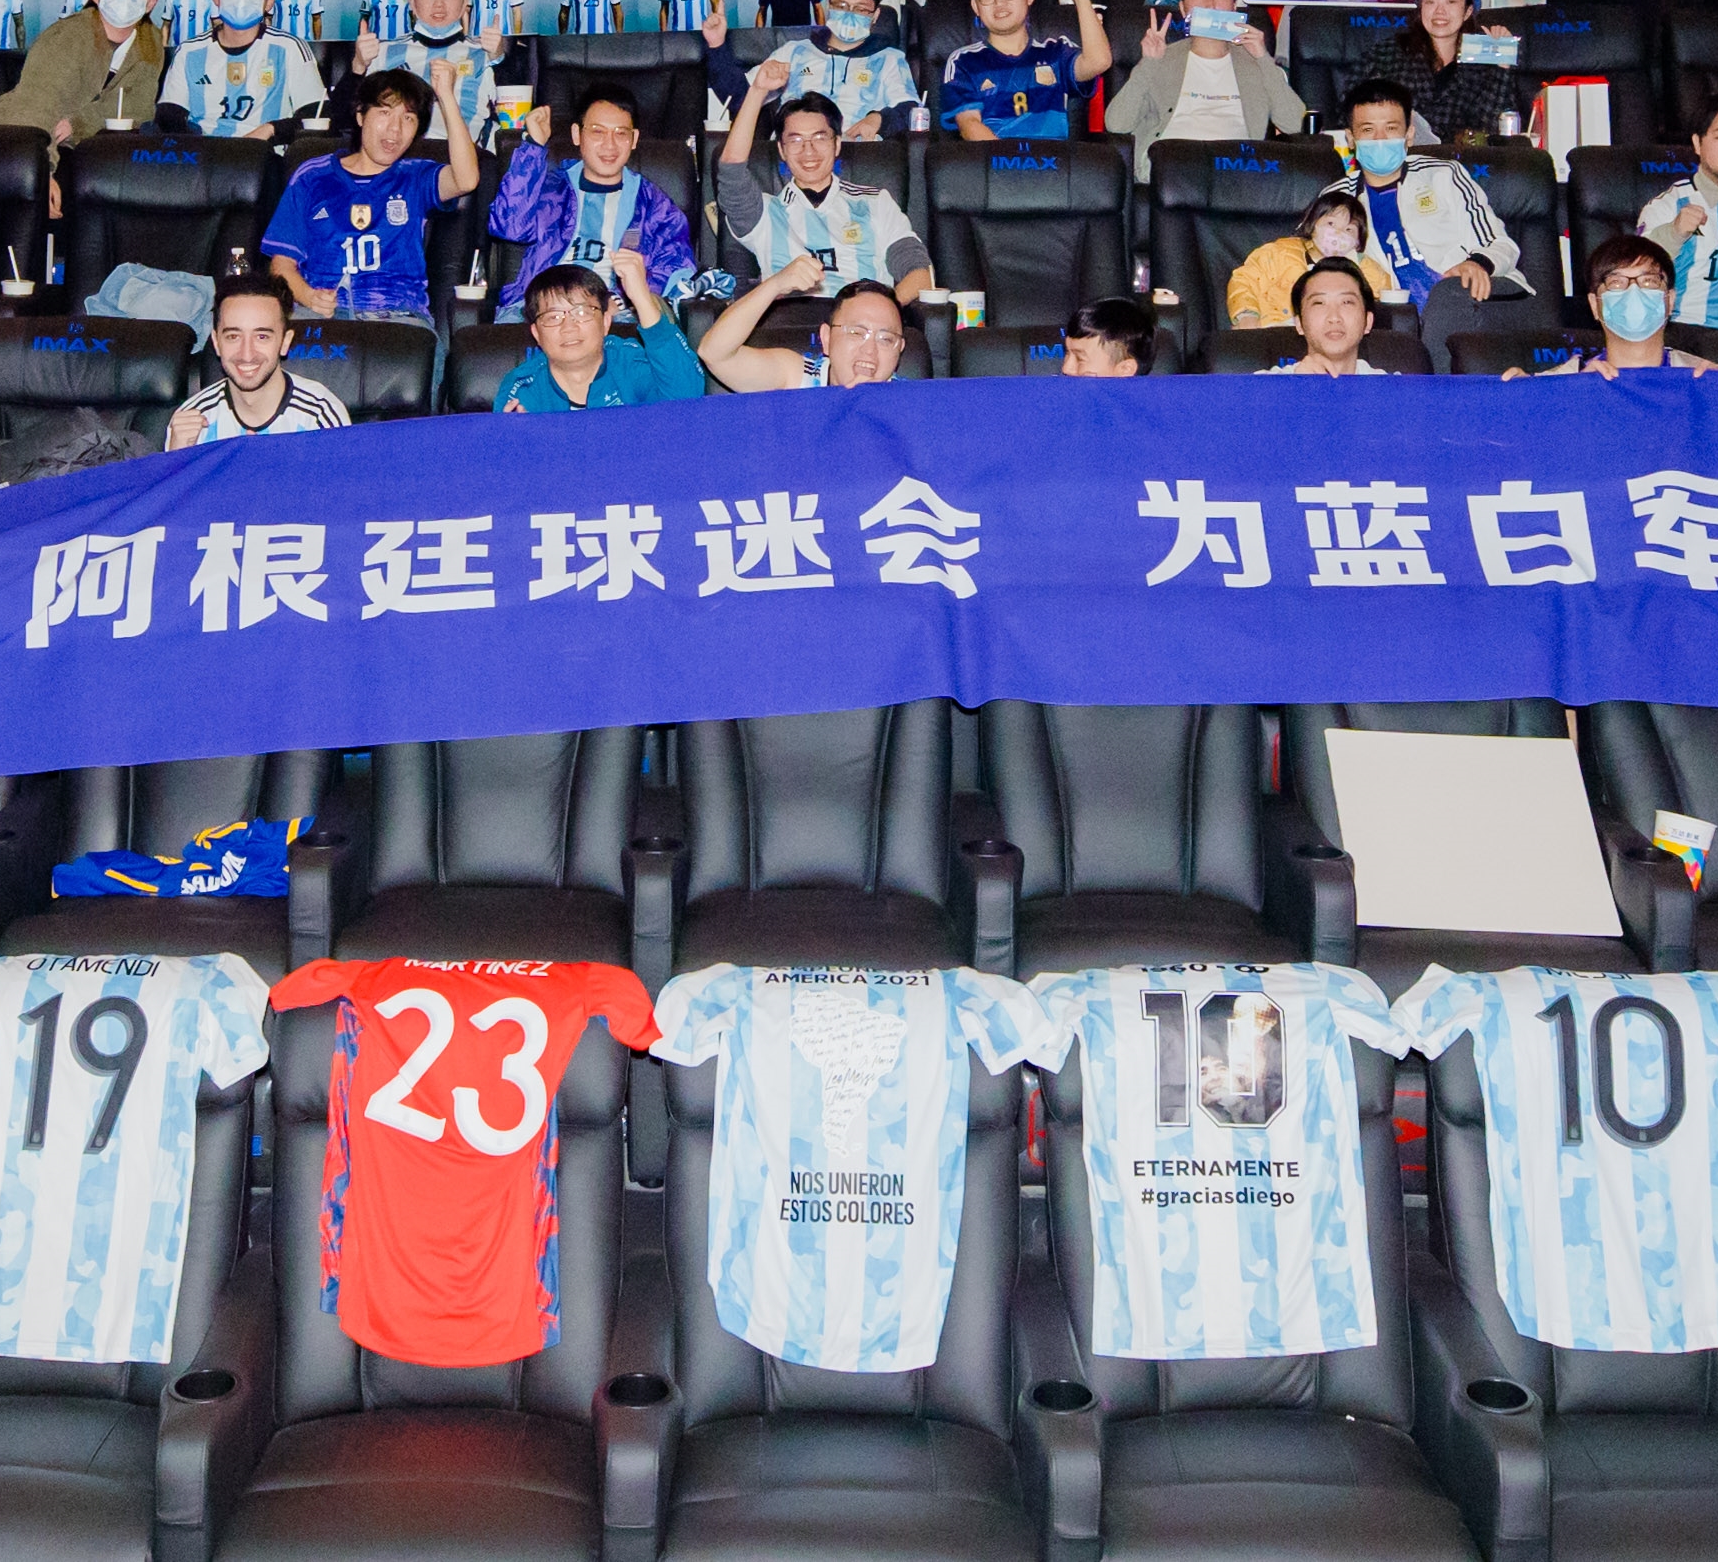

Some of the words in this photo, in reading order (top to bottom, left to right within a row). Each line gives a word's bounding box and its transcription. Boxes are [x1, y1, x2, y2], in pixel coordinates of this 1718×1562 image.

[188, 9, 197, 22] 9
[287, 4, 301, 18] 16
[385, 4, 399, 17] 17
[1350, 15, 1408, 29] IMAX
[1534, 19, 1592, 35] IMAX
[220, 95, 255, 121] 10
[1012, 91, 1028, 114] 8
[131, 150, 198, 166] IMAX
[991, 155, 1058, 172] IMAX
[1215, 157, 1280, 173] IMAX
[342, 235, 382, 275] 10
[32, 336, 110, 353] IMAX
[287, 344, 350, 361] MAX
[27, 955, 160, 978] OTAMENDI
[765, 973, 868, 985] AMERICA
[874, 974, 930, 987] 2021
[1138, 988, 1287, 1130] 10
[17, 993, 150, 1155] 19
[364, 988, 549, 1157] 23
[1535, 994, 1684, 1150] 10
[1132, 1159, 1301, 1179] ETERNAMENTE
[790, 1171, 825, 1197] NOS
[828, 1171, 905, 1198] UNIERON
[1140, 1185, 1296, 1208] #graciasdiego
[779, 1198, 832, 1223] ESTOS
[837, 1200, 915, 1226] COLORES
